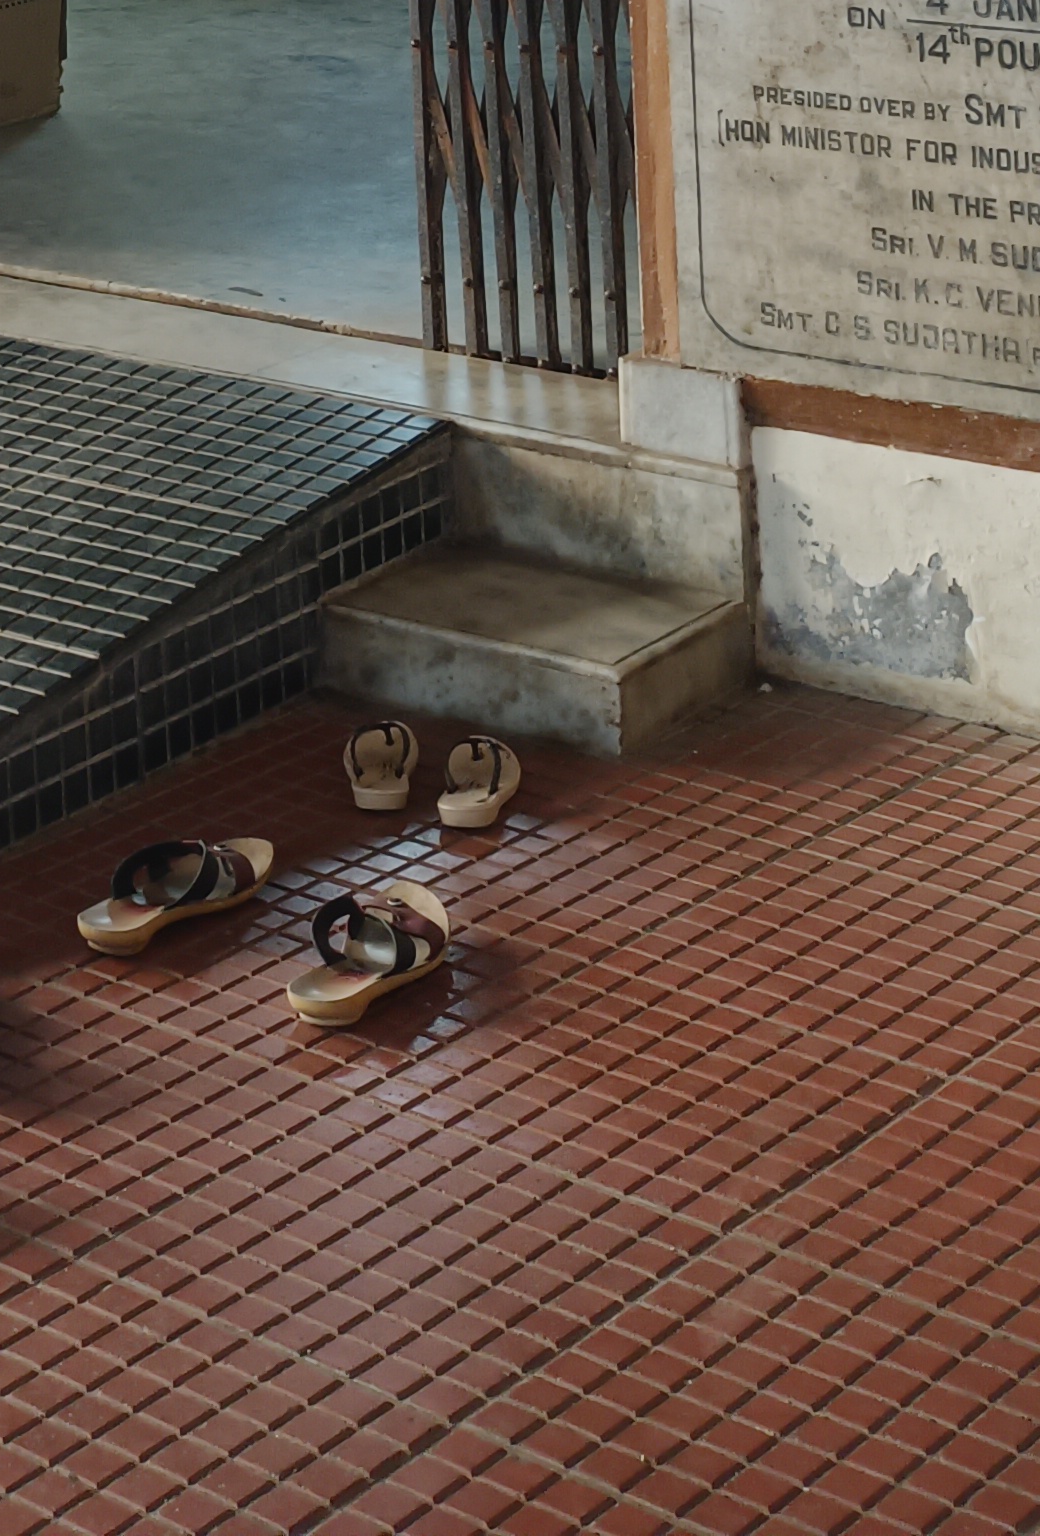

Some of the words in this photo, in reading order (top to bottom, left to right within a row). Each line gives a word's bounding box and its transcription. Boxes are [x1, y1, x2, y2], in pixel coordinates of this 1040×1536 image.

[847, 6, 886, 29] ON
[752, 85, 852, 112] PRESIDED
[859, 96, 916, 119] OVER
[923, 102, 951, 122] BY
[780, 124, 892, 159] MINISTOR
[906, 138, 958, 166] FOR
[911, 188, 935, 213] IN
[947, 193, 998, 220] THE
[976, 285, 1040, 318] VEN
[883, 319, 1021, 365] SUJATHA
